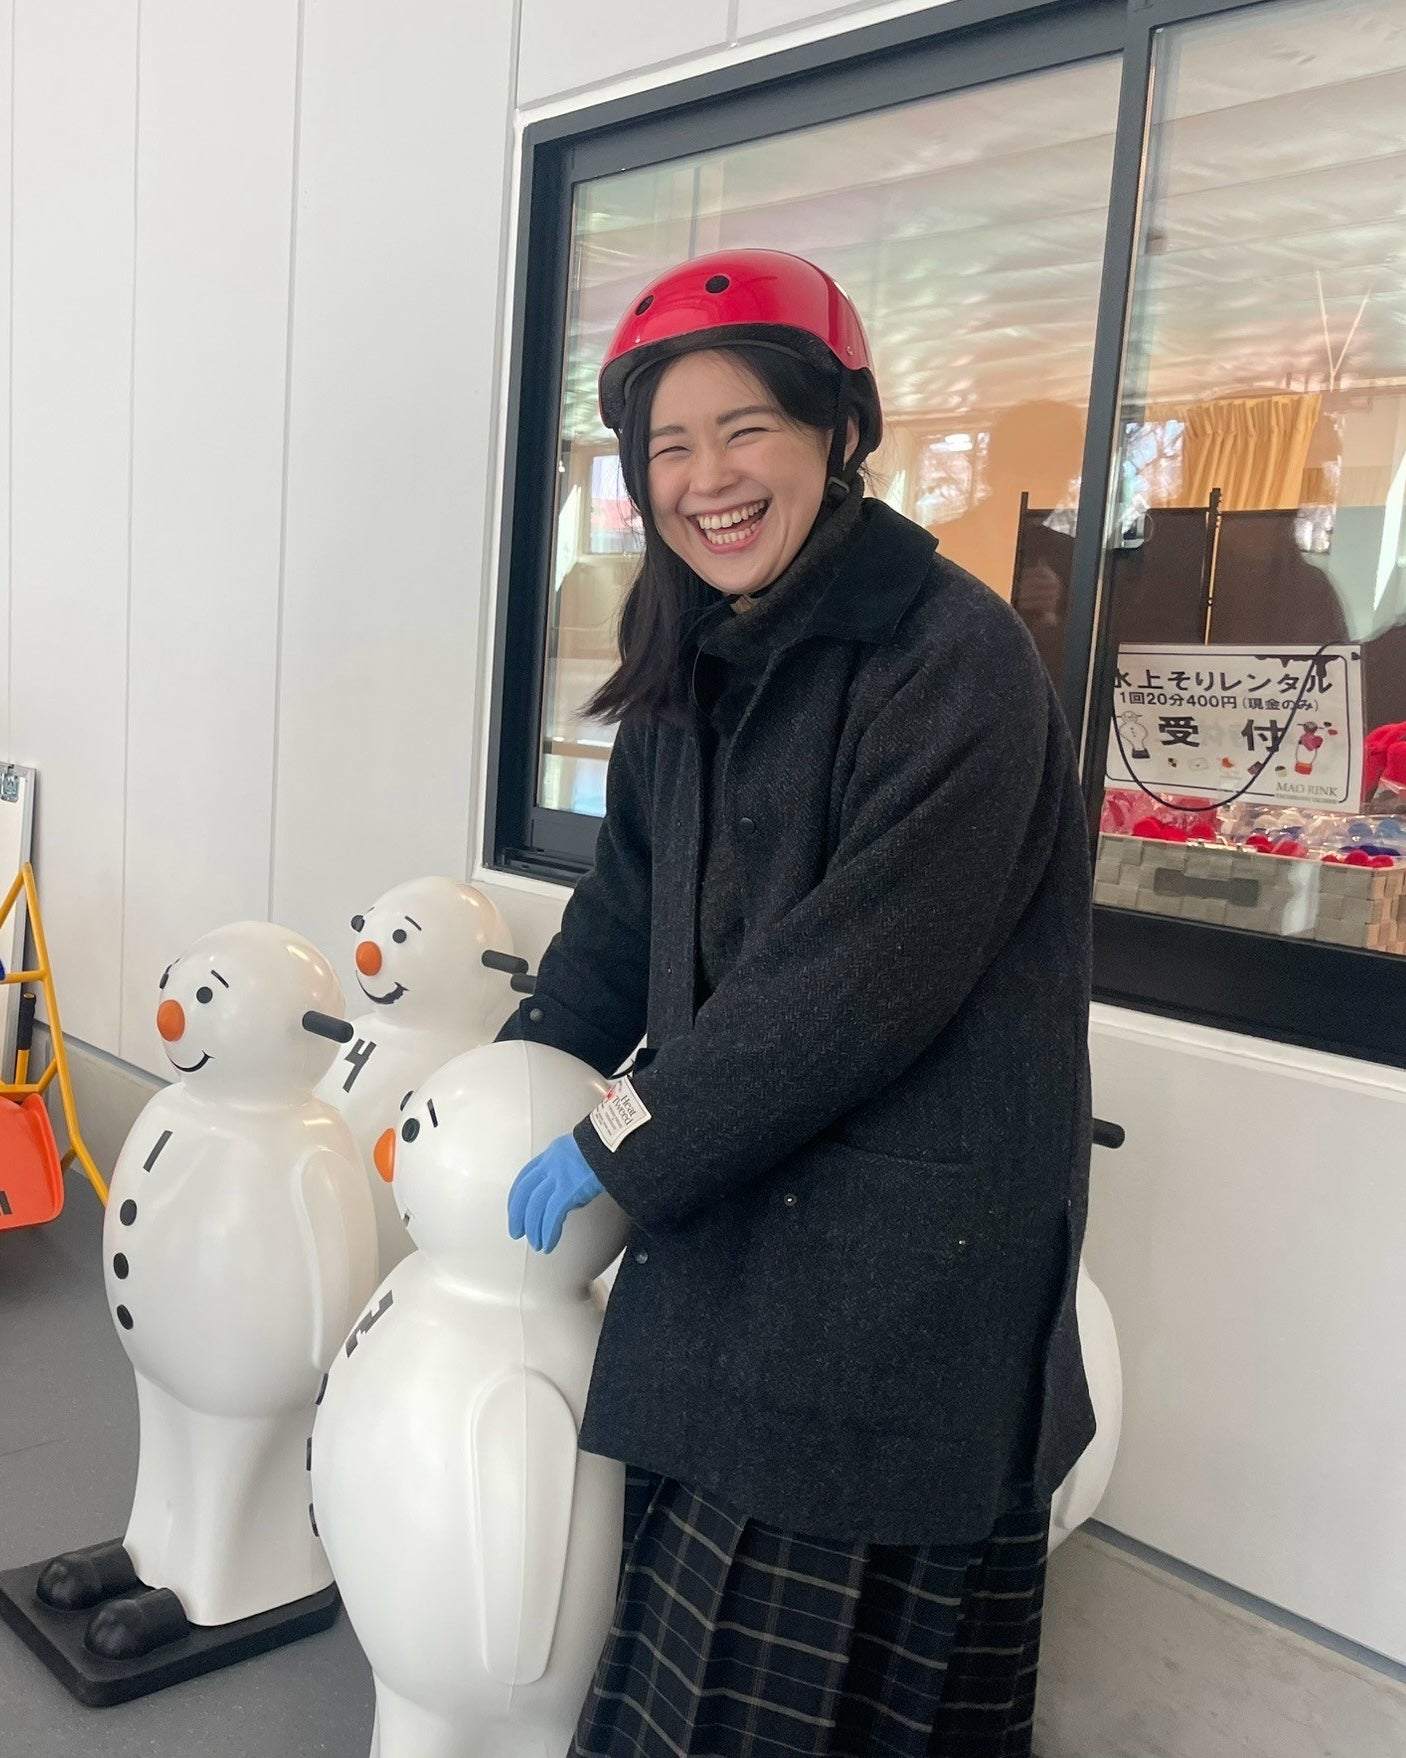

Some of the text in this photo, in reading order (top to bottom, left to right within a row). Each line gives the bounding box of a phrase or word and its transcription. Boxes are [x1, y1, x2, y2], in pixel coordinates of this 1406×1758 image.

[1276, 782, 1338, 796] MAO RINK
[343, 1038, 377, 1093] 4
[612, 1096, 633, 1125] Tweed
[620, 1095, 636, 1117] Heat
